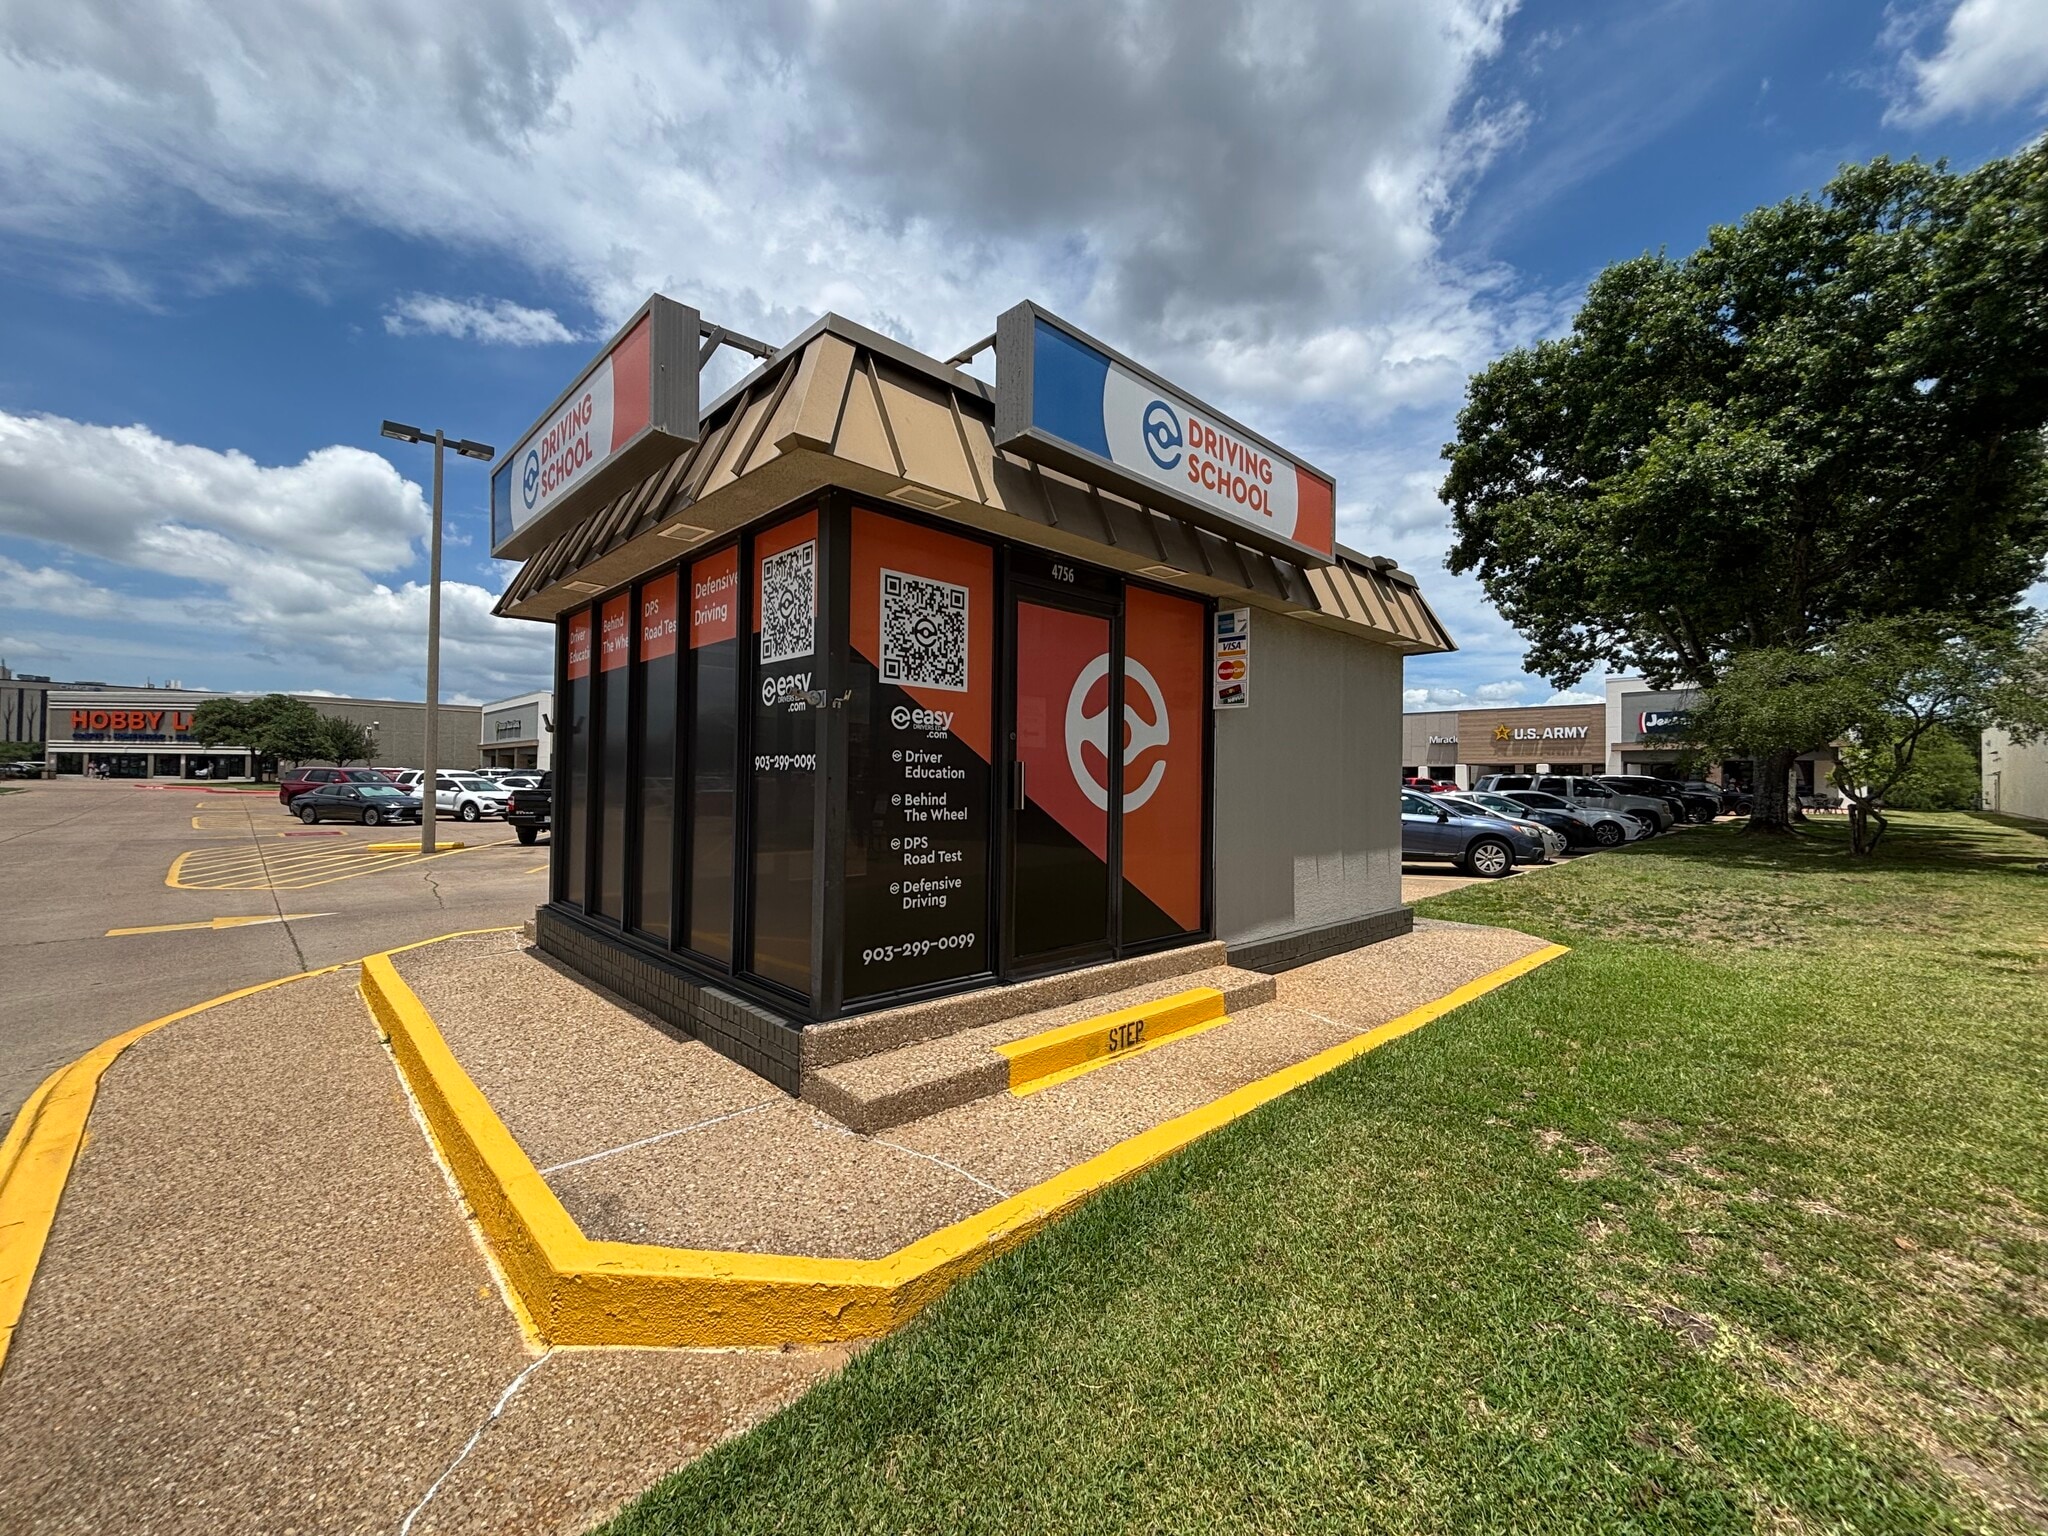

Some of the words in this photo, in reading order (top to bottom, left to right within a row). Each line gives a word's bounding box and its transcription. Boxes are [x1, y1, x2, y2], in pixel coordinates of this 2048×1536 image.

[541, 393, 592, 465] DRIVING
[1188, 417, 1273, 485] DRIVING
[541, 431, 593, 497] SCHOOL
[1188, 454, 1273, 518] SCHOOL
[1052, 564, 1074, 583] 4756
[644, 599, 659, 617] DPS
[695, 602, 727, 626] Driving
[604, 611, 624, 633] Behind
[644, 620, 663, 641] Road
[664, 619, 677, 634] Tes
[571, 629, 586, 644] Driver
[603, 639, 614, 654] The
[615, 634, 628, 650] Whe
[570, 645, 590, 664] Educati
[1222, 641, 1241, 651] VISA
[788, 701, 806, 712] .com
[70, 709, 164, 730] HOBBY
[172, 710, 194, 731] L
[912, 709, 954, 730] easy
[926, 731, 948, 739] .com
[1514, 728, 1540, 740] U.S.
[1542, 726, 1588, 739] ARMY
[905, 750, 942, 763] Driver
[905, 765, 965, 779] Education
[904, 792, 947, 806] Behind
[904, 809, 927, 822] The
[930, 807, 968, 821] Wheel
[904, 836, 928, 850] DPS
[903, 850, 935, 866] Road
[938, 850, 962, 863] Test
[903, 876, 962, 893] Defensive
[903, 893, 947, 909] Driving
[862, 933, 975, 965] 903-299-0099
[1109, 1020, 1145, 1052] STEP
